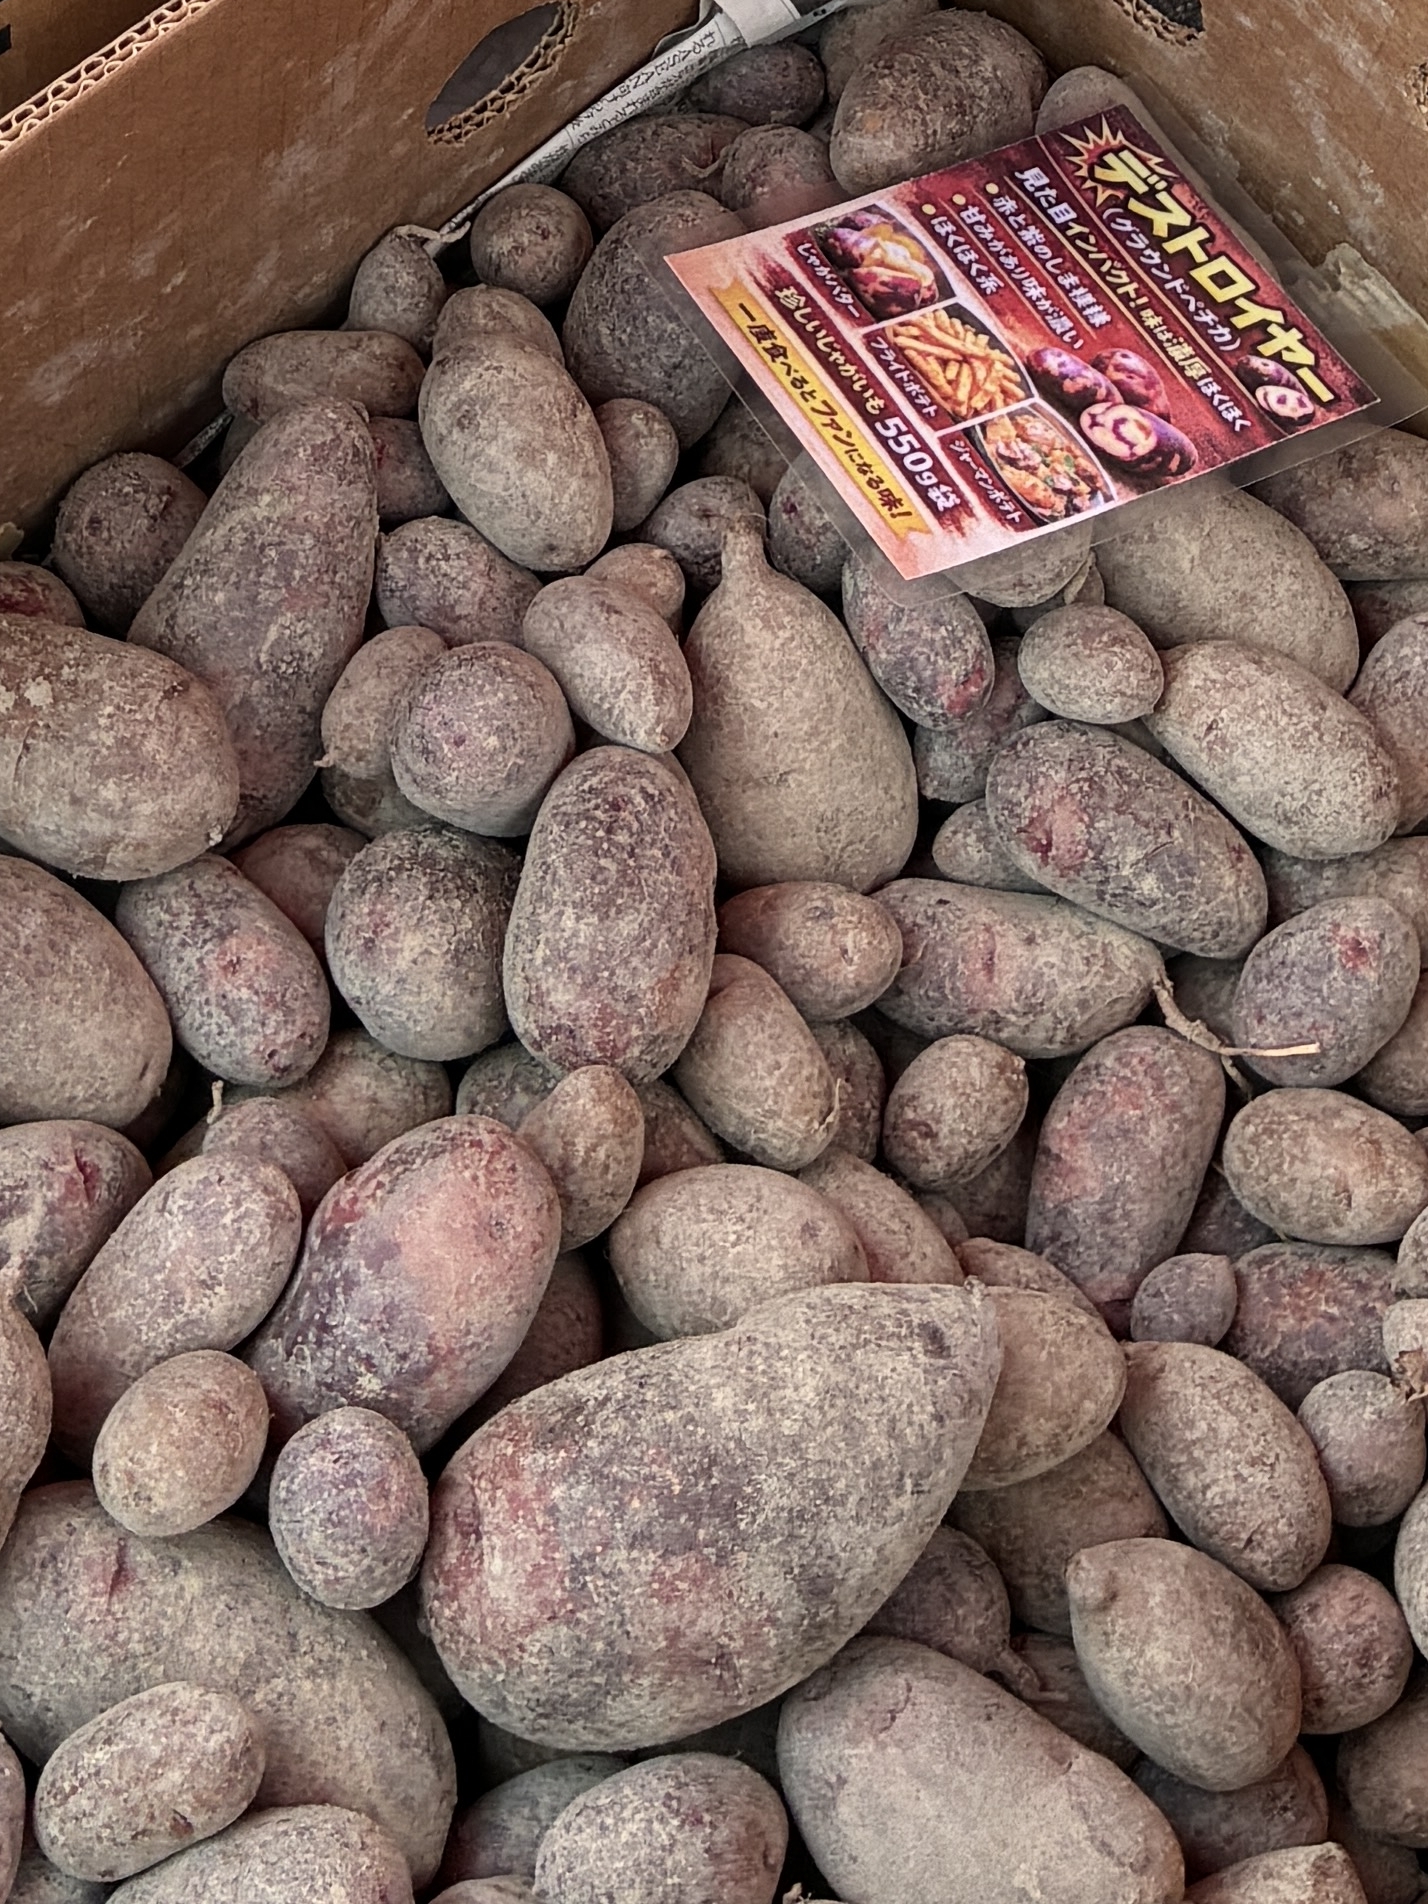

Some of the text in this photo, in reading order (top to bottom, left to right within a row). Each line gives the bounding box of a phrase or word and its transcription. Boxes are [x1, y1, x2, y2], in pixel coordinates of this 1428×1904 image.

[794, 242, 863, 321] じゃがバター
[927, 216, 1001, 296] ほくほく系
[958, 203, 1084, 350] 甘みがあり味が濃い
[992, 194, 1112, 329] 赤と紫のしま模様
[1014, 166, 1150, 309] 見た目インパクト!
[1093, 149, 1335, 404] デストロイヤー
[1103, 206, 1241, 352] （グラウンドペチカ）
[735, 303, 916, 521] 一度食べるとファンになる味!
[774, 286, 961, 515] 珍しいじゃがいも 550g袋
[871, 334, 939, 418] フライドポテト
[947, 438, 1023, 526] ジャーマンポテト
